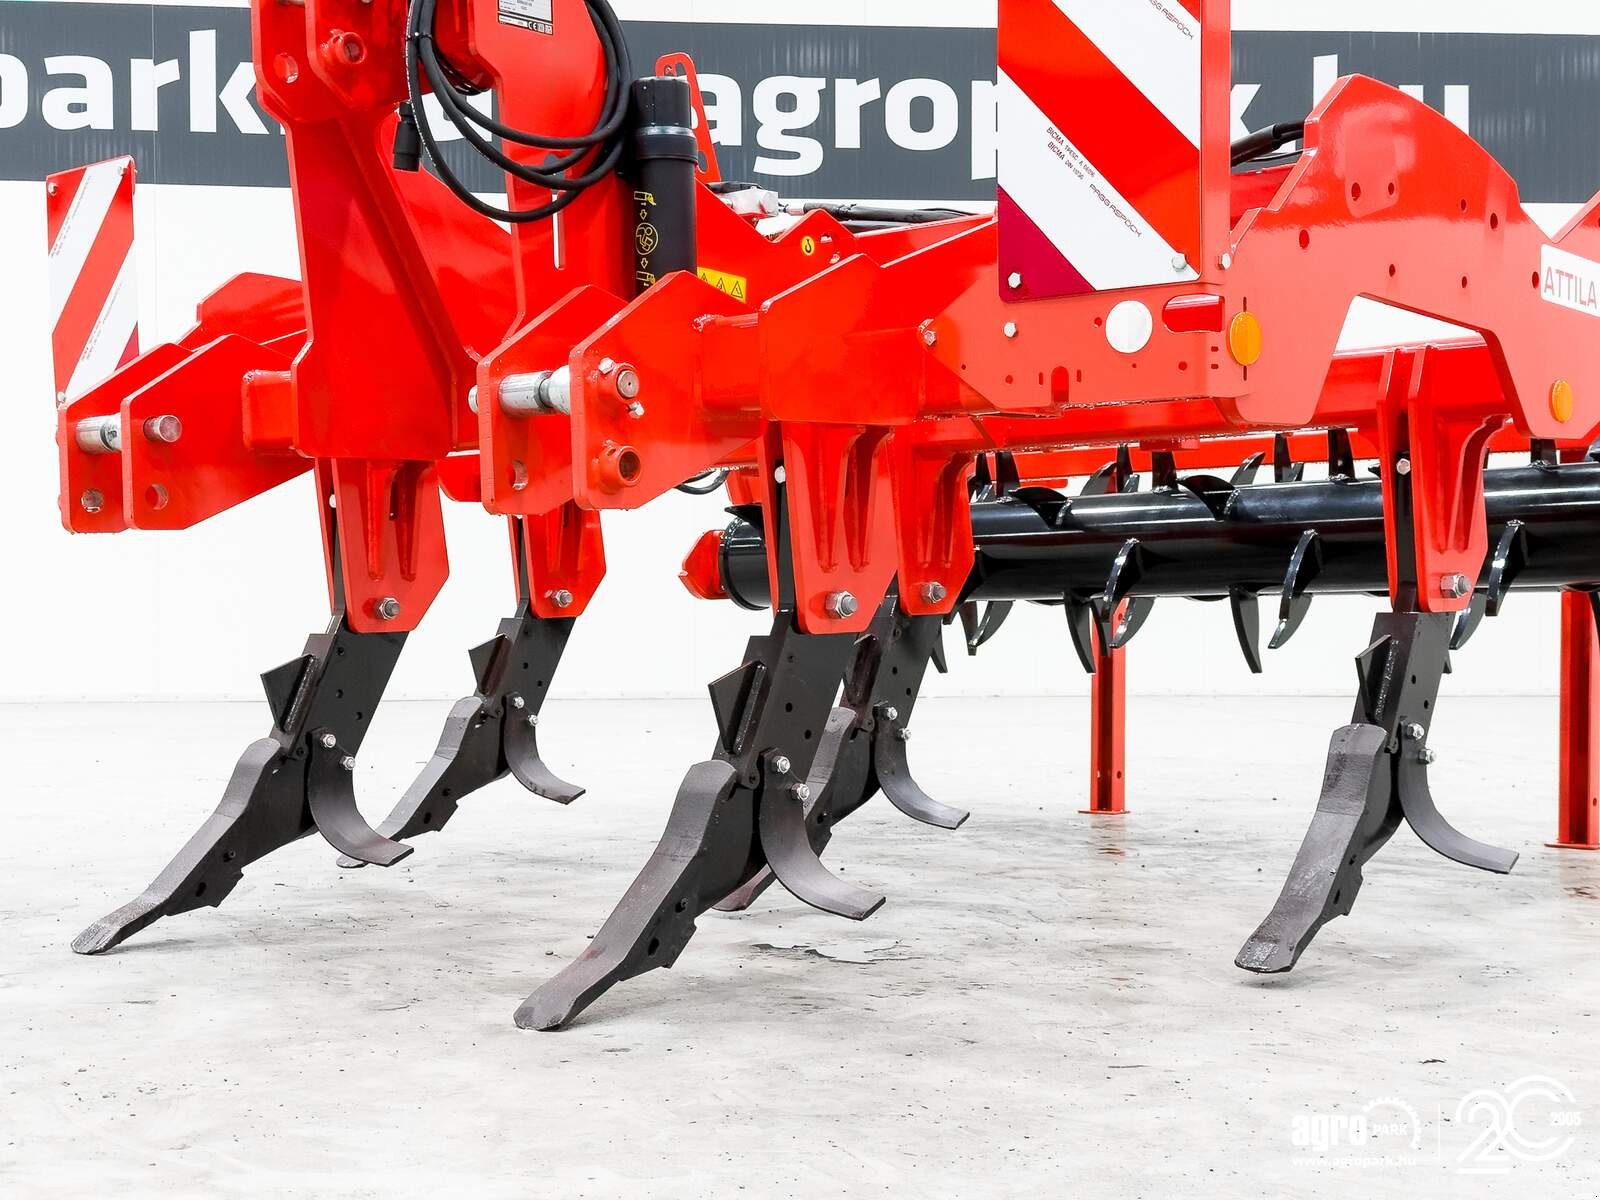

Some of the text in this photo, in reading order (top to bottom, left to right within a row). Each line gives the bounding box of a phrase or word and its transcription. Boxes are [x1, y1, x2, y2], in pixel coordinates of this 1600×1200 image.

[1046, 126, 1065, 146] BICMA
[1047, 141, 1065, 160] BICMA
[1543, 265, 1598, 310] ATTILA
